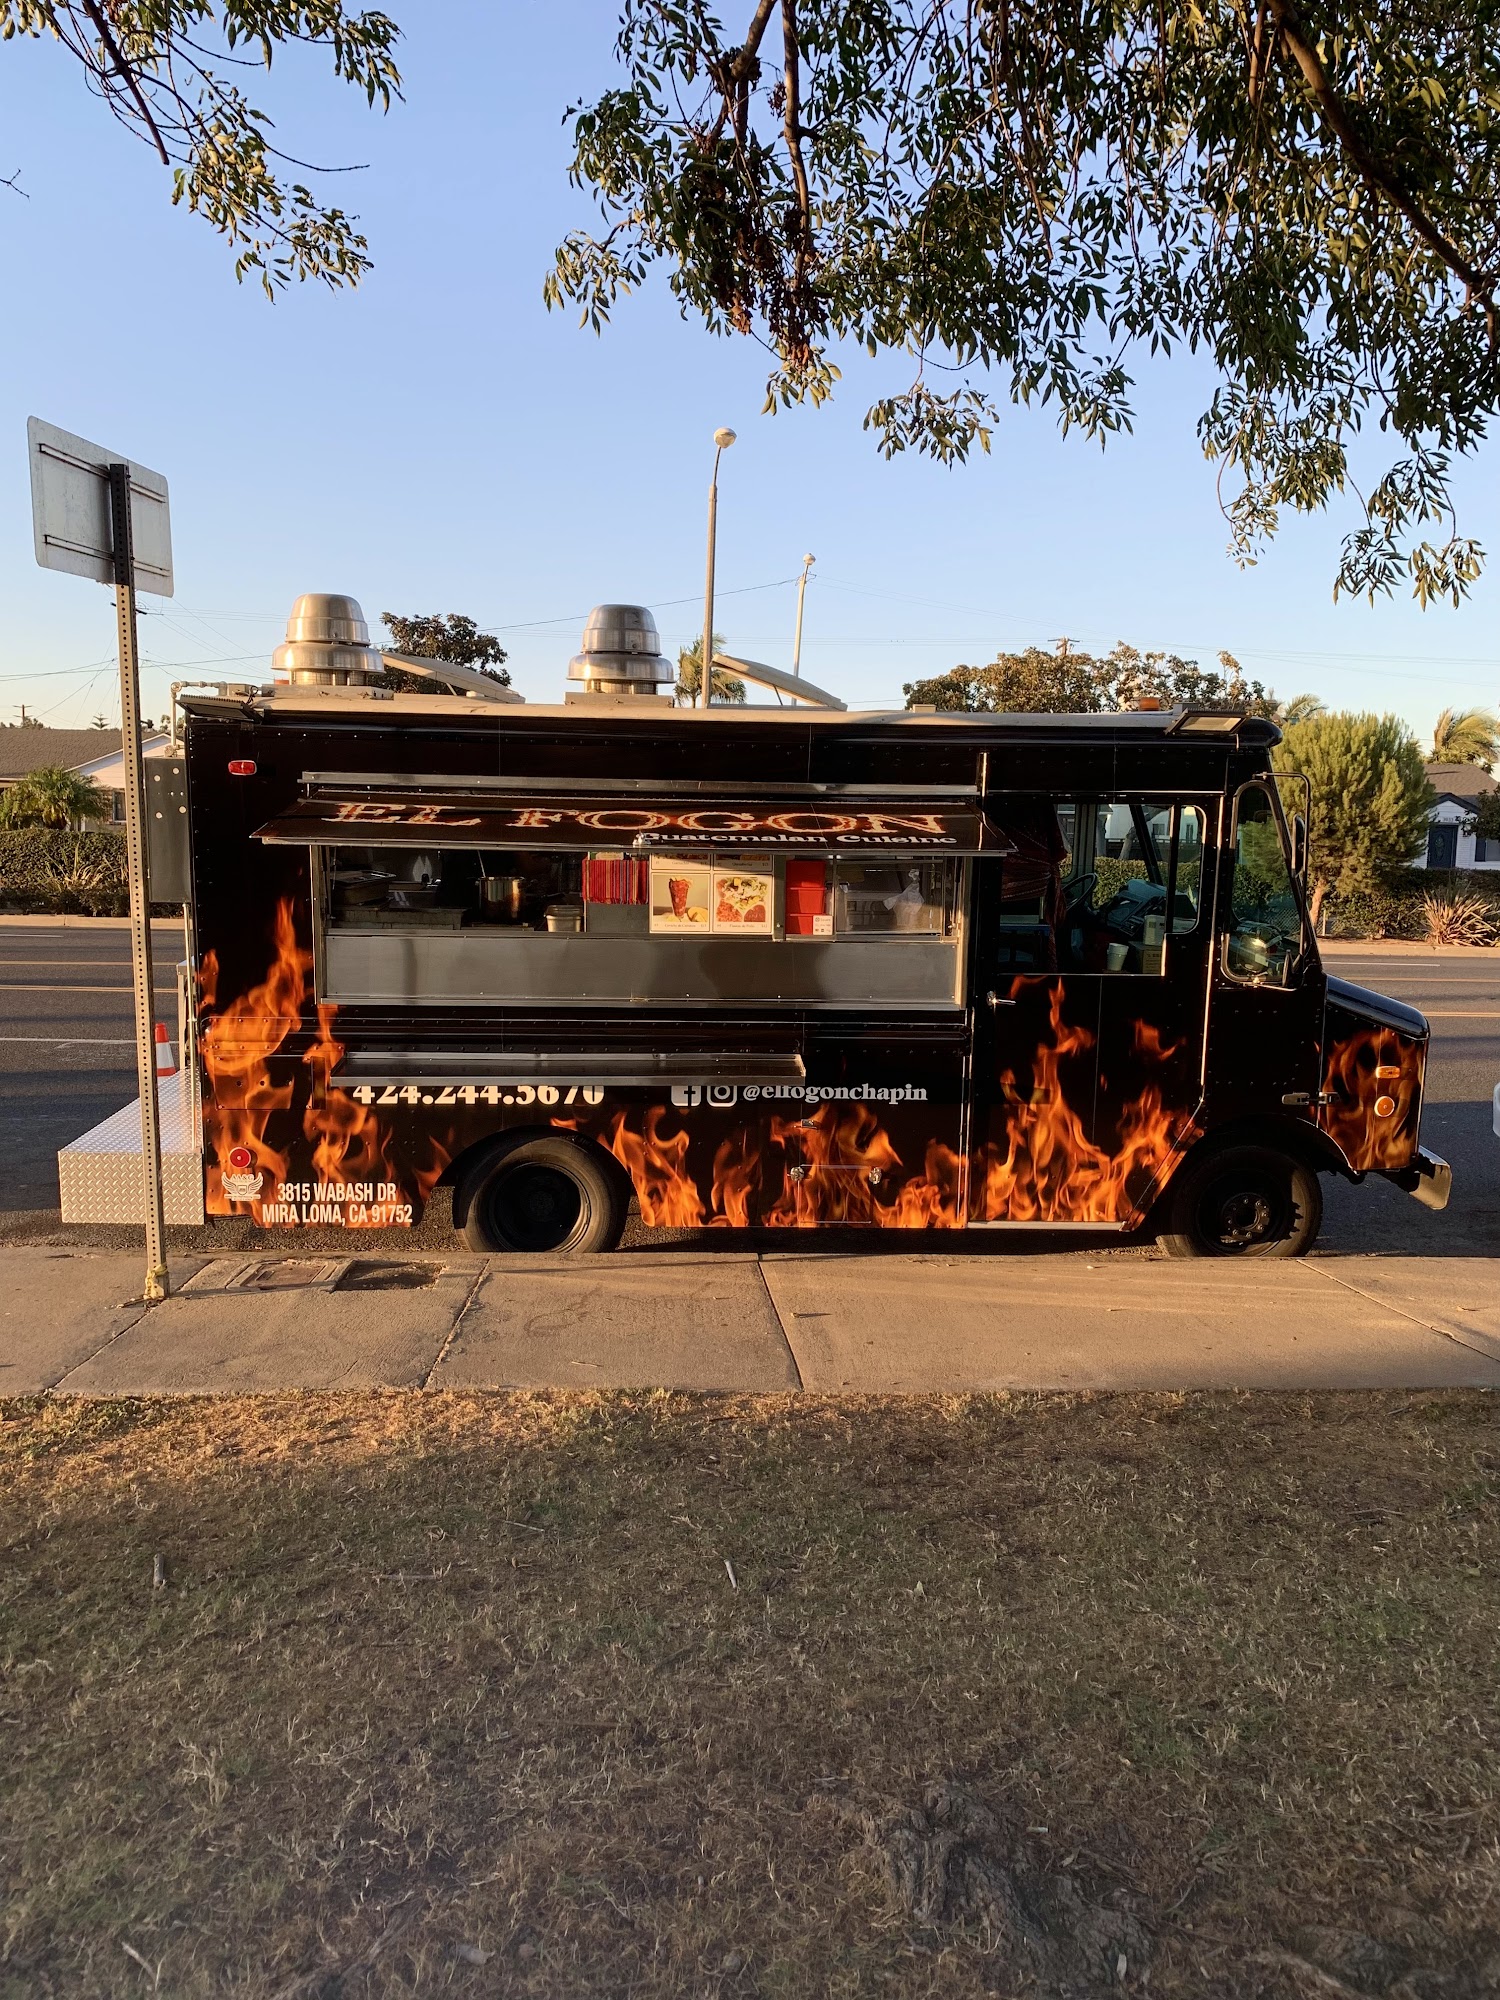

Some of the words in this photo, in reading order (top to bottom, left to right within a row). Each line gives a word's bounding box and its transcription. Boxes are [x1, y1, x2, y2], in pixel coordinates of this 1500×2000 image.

[321, 802, 481, 826] EL
[505, 807, 947, 834] FOGON
[836, 834, 957, 845] Cuisine
[353, 1085, 605, 1105] 424.244.5670
[743, 1083, 928, 1105] @elfogonchapin
[277, 1182, 311, 1202] 3815
[313, 1182, 374, 1202] WABASH
[377, 1182, 397, 1202] DR
[262, 1204, 300, 1223] MIRA
[302, 1204, 346, 1226] LOMA,
[349, 1204, 368, 1223] CA
[371, 1204, 413, 1223] 91752
